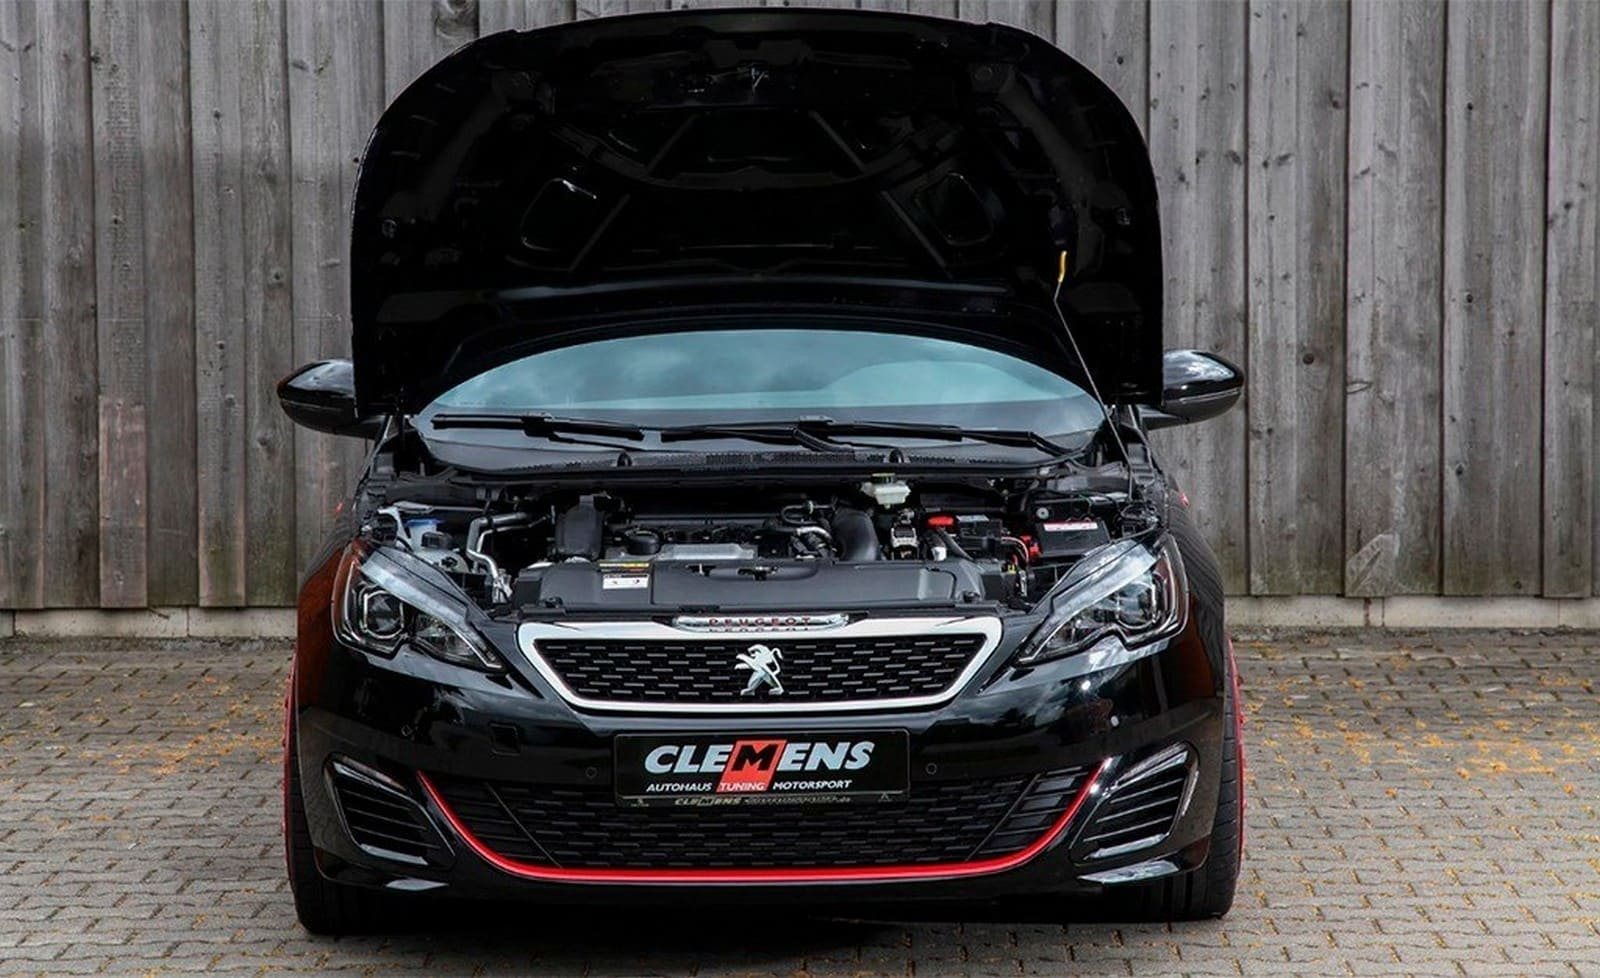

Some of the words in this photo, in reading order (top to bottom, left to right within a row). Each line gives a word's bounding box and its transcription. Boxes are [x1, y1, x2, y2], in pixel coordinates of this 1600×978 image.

[708, 616, 811, 627] PEUGEOT
[645, 741, 875, 774] CLEMENS
[646, 782, 712, 793] AUTOHAUS
[719, 781, 766, 792] TUNING
[773, 779, 852, 791] MOTORSPORT
